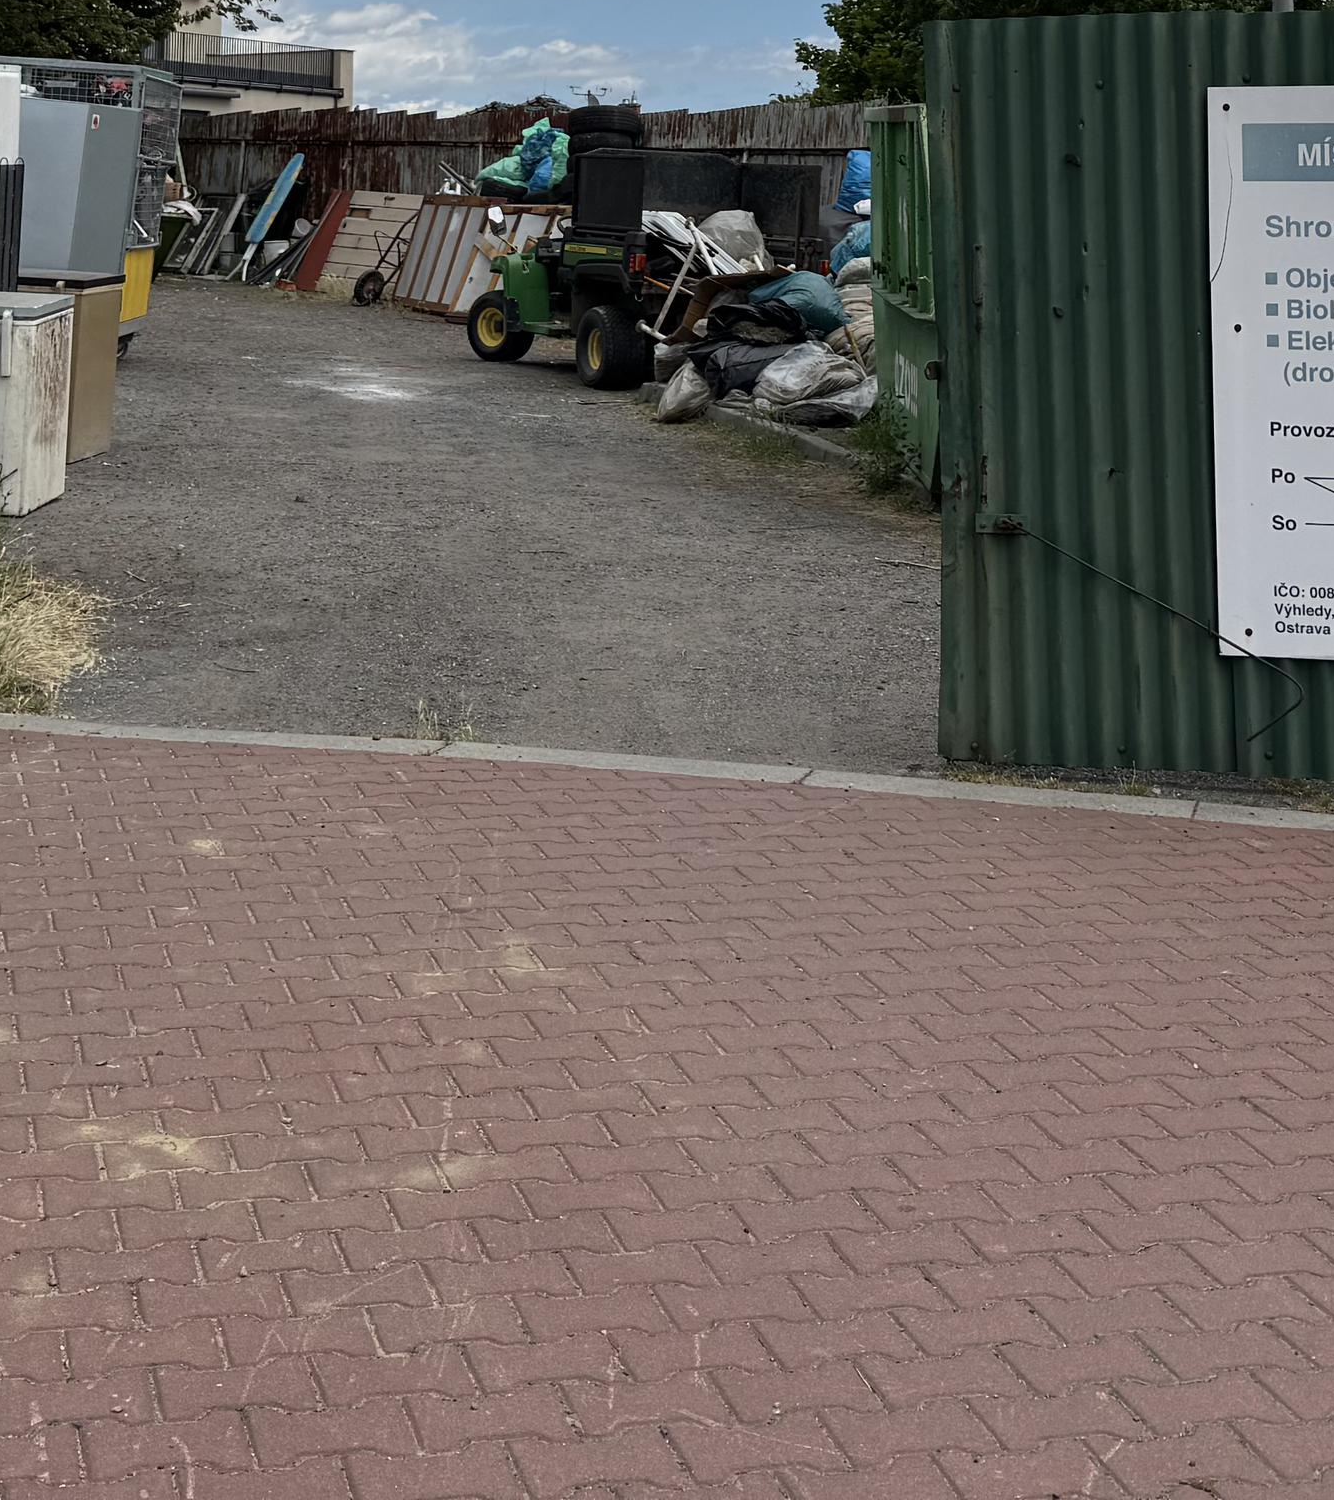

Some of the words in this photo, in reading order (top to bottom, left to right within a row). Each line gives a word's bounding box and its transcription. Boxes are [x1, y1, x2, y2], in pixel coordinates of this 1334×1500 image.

[1271, 467, 1296, 484] Po
[1271, 514, 1297, 531] So
[1273, 581, 1306, 601] IČO:
[1274, 620, 1332, 636] Ostrava
